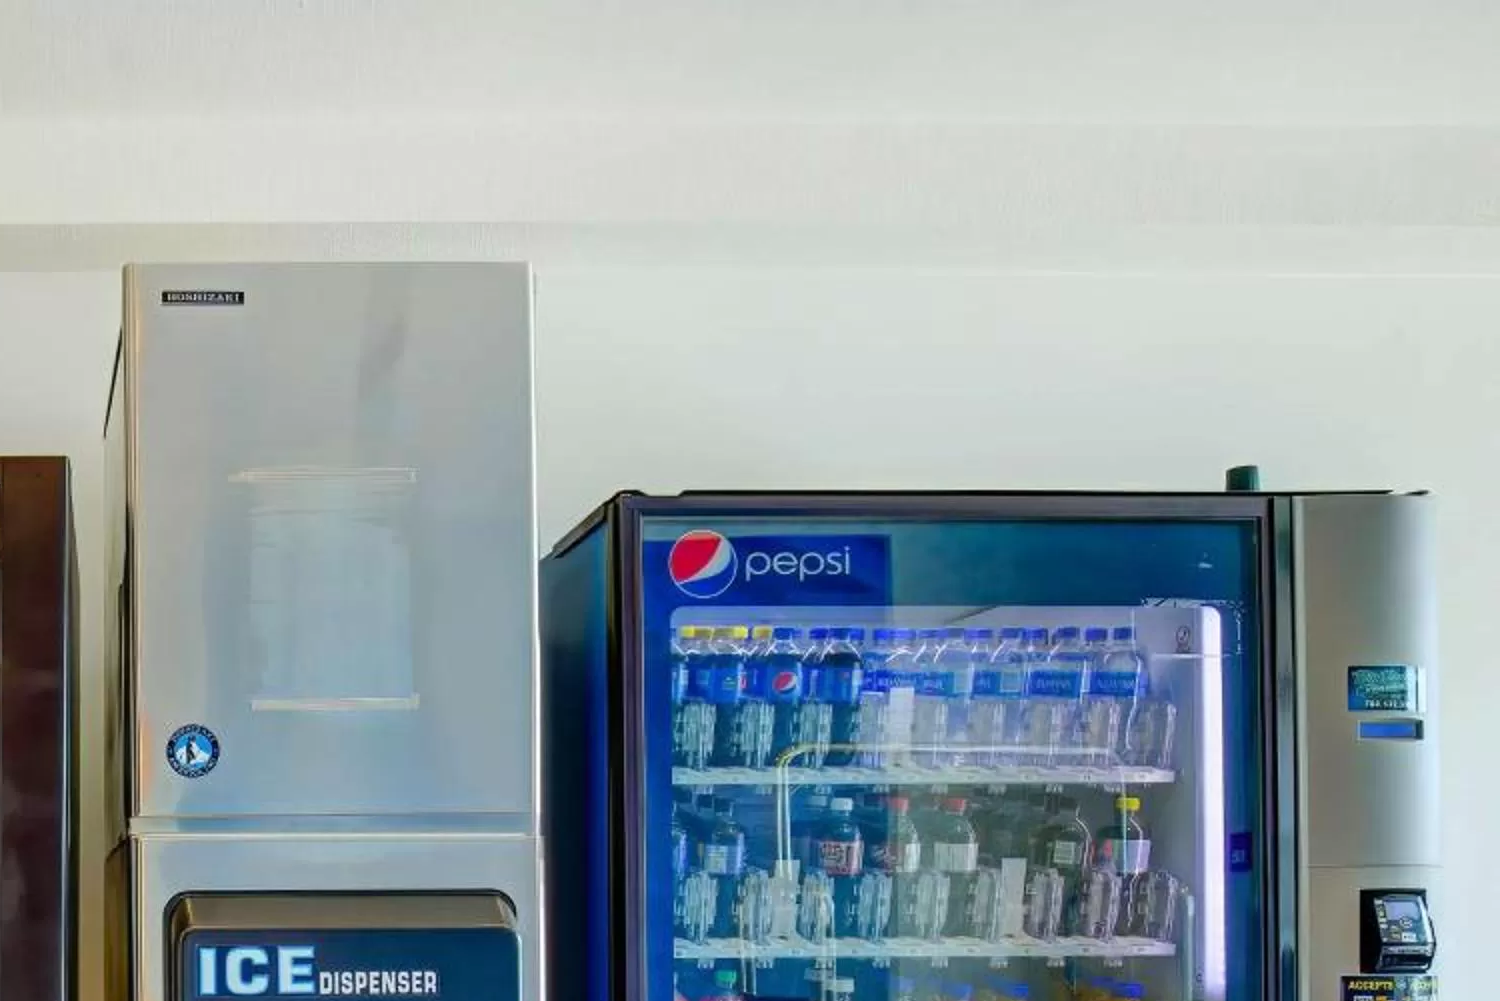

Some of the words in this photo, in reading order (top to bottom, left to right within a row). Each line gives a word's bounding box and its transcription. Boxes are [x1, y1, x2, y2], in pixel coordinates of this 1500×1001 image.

[745, 545, 851, 583] pepsi
[199, 946, 315, 996] ICE
[319, 971, 437, 995] DISPENSER
[1348, 980, 1394, 991] ACCEPTS
